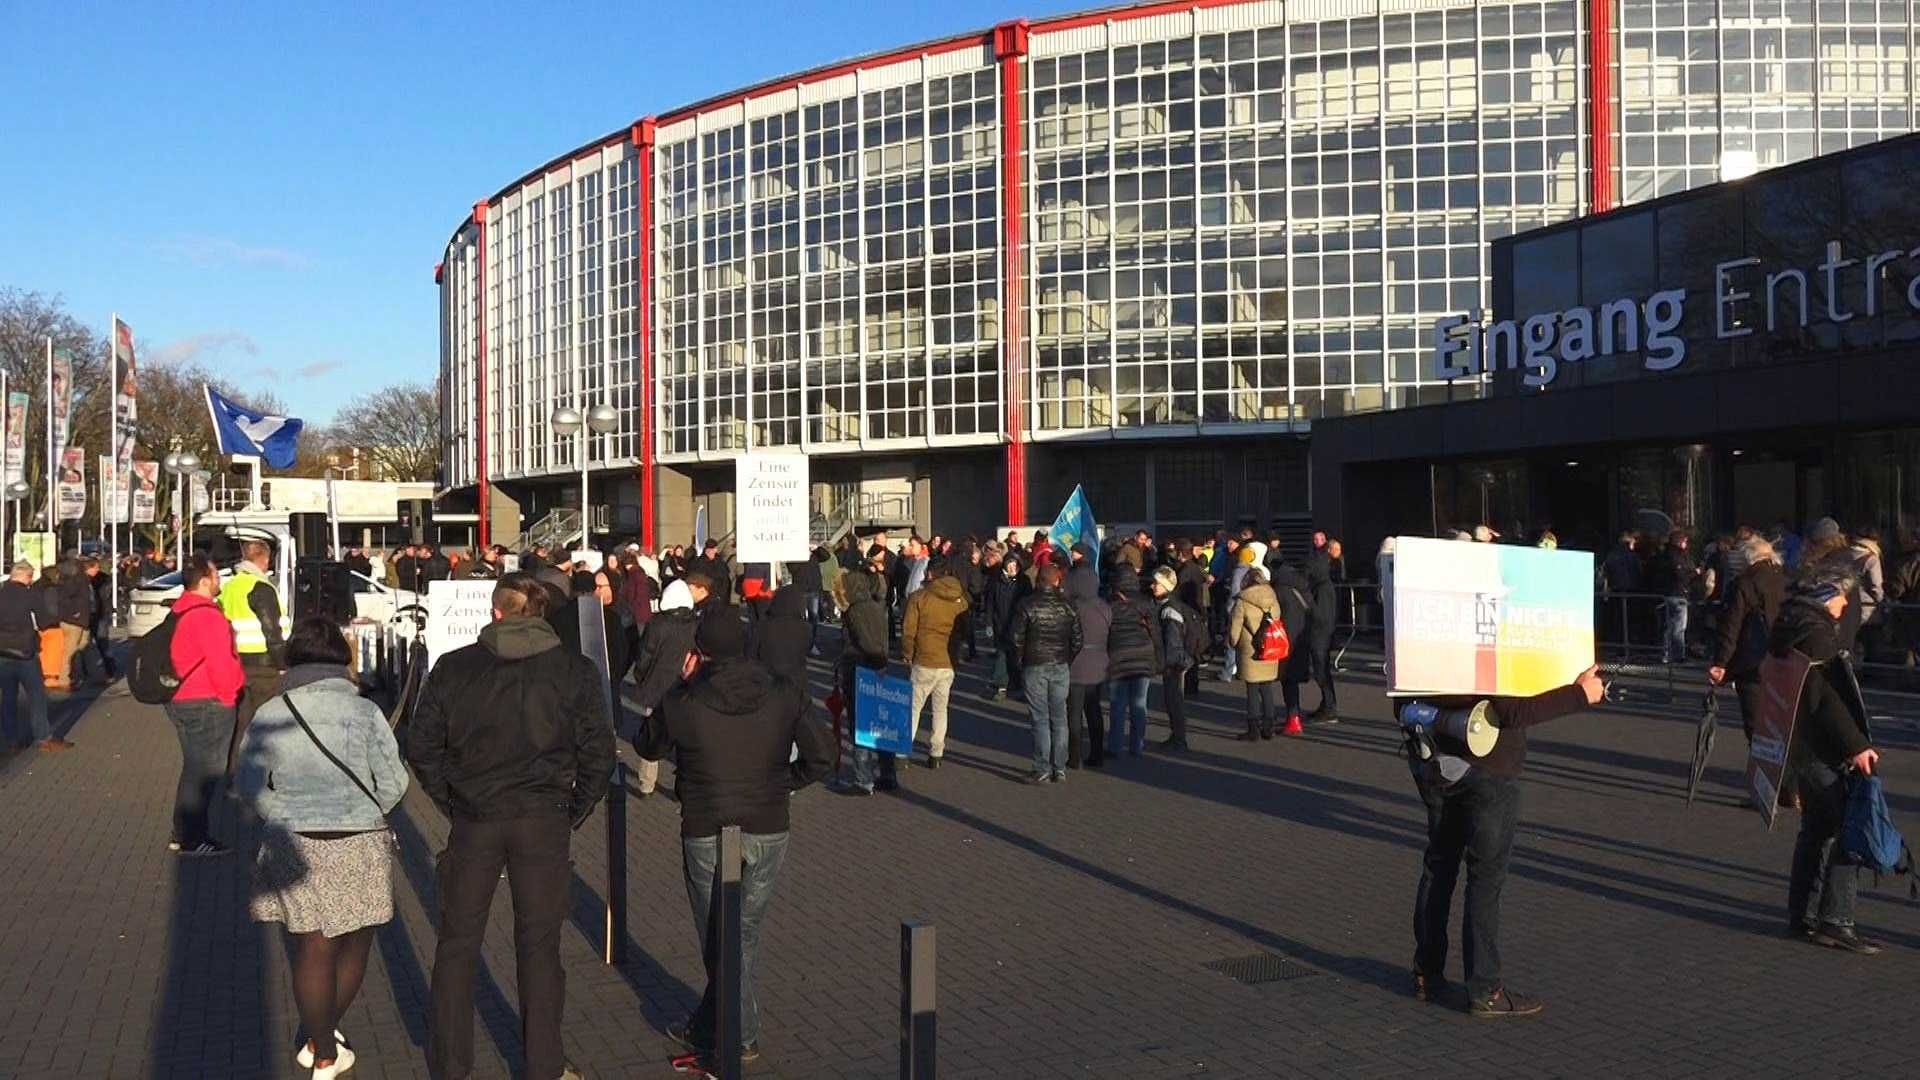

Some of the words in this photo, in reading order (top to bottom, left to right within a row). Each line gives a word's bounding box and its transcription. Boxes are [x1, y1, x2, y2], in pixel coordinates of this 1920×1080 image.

[1435, 287, 1686, 386] Eingang
[758, 460, 791, 473] Eine
[748, 477, 799, 490] Zensur
[752, 494, 793, 508] findet
[447, 622, 479, 636] find
